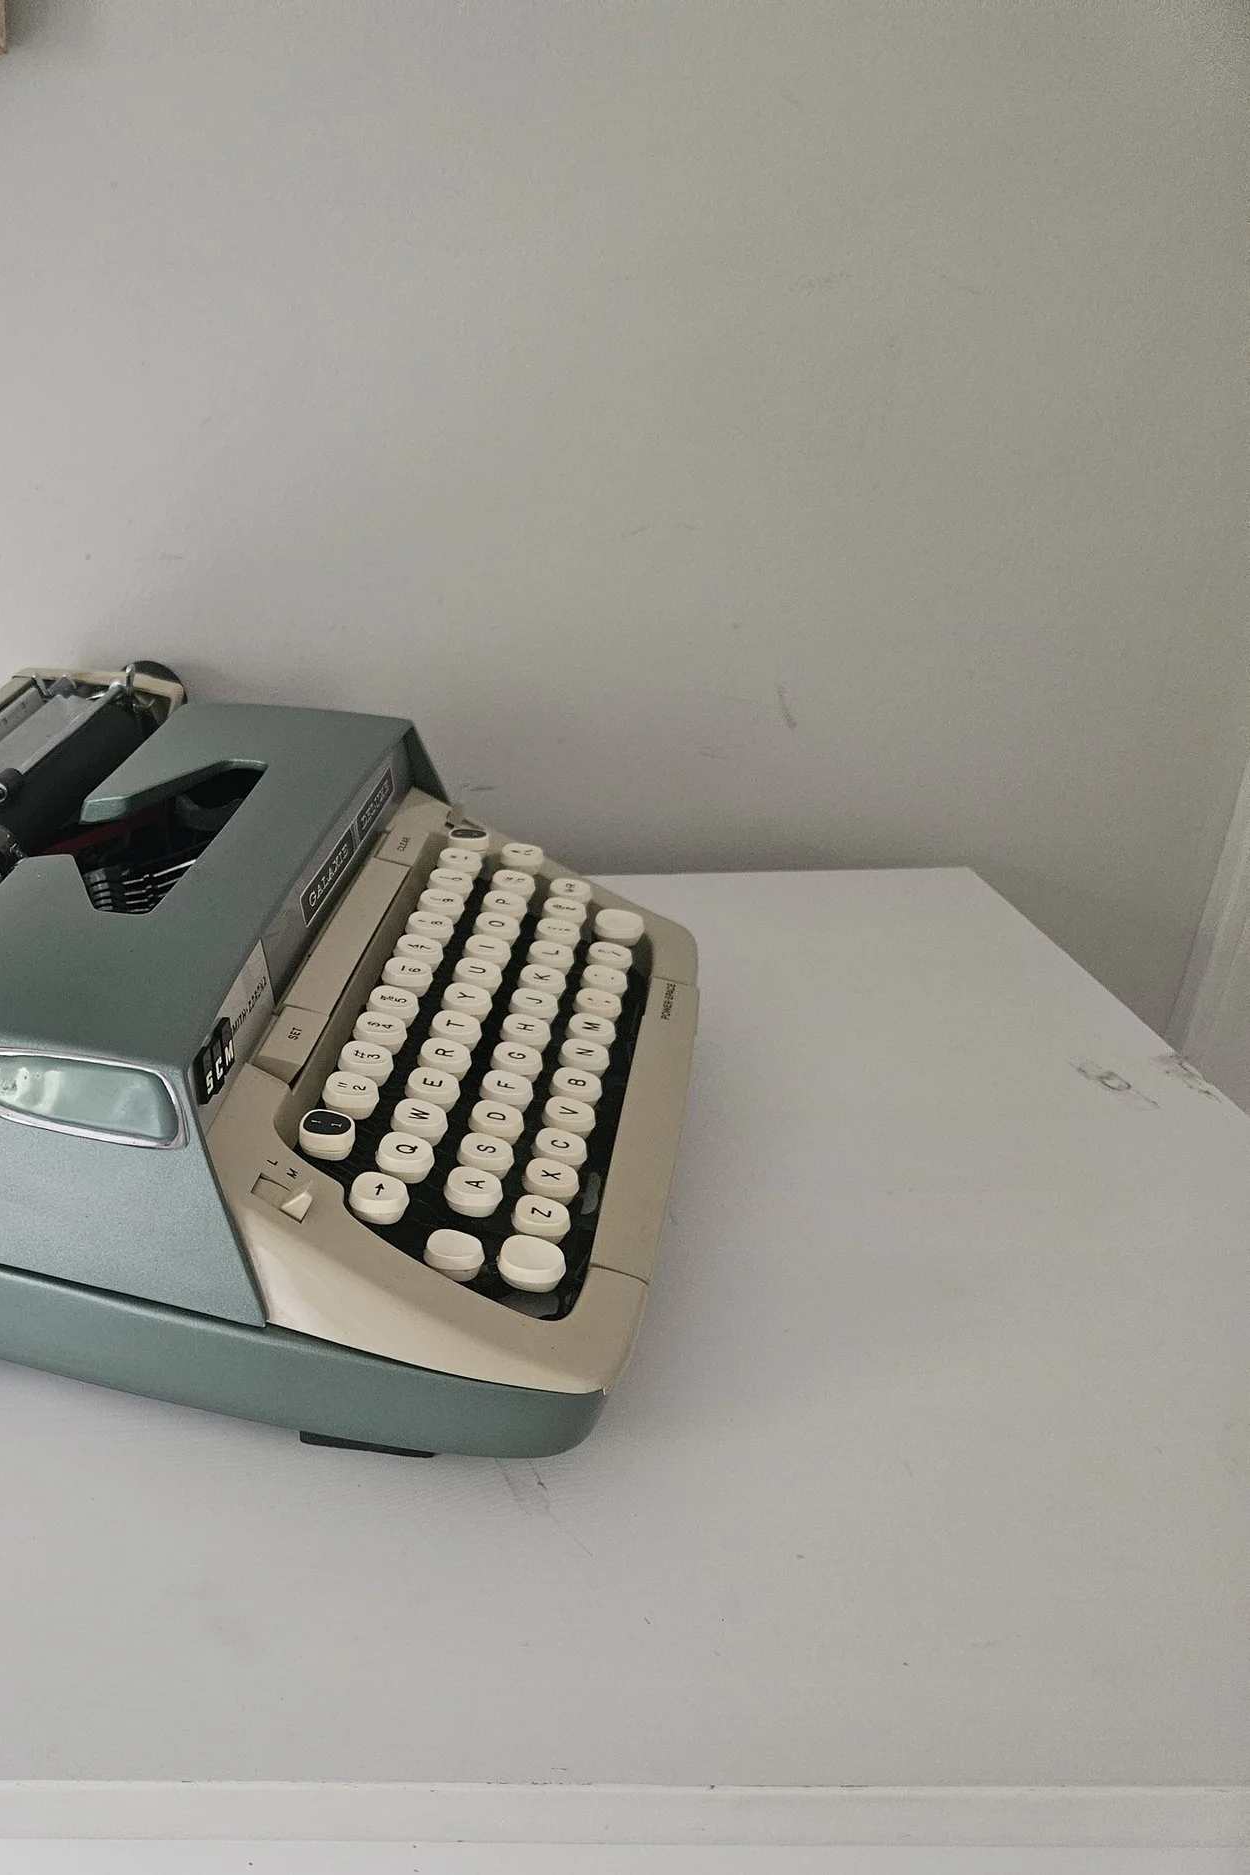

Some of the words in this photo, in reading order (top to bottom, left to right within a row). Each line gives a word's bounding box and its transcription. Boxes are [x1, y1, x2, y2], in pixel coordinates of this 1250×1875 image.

[309, 843, 349, 907] GALAXIE
[468, 965, 486, 974] U
[533, 972, 551, 981] K
[457, 991, 476, 999] Y
[526, 996, 543, 1004] J
[446, 1019, 465, 1027] T
[516, 1022, 535, 1031] H
[582, 1021, 601, 1031] M
[287, 1027, 302, 1040] SET
[435, 1048, 455, 1057] R
[507, 1051, 526, 1060] G
[575, 1047, 595, 1056] N
[205, 1039, 235, 1095] SCM
[423, 1077, 443, 1088] E
[496, 1080, 516, 1090] F
[567, 1078, 587, 1087] B
[408, 1107, 430, 1120] W
[558, 1105, 579, 1115] V
[486, 1111, 507, 1121] D
[476, 1144, 497, 1154] S
[550, 1139, 570, 1149] C
[395, 1144, 419, 1155] Q
[286, 1167, 299, 1180] M
[540, 1169, 562, 1181] X
[464, 1180, 486, 1190] A
[530, 1206, 552, 1218] Z
